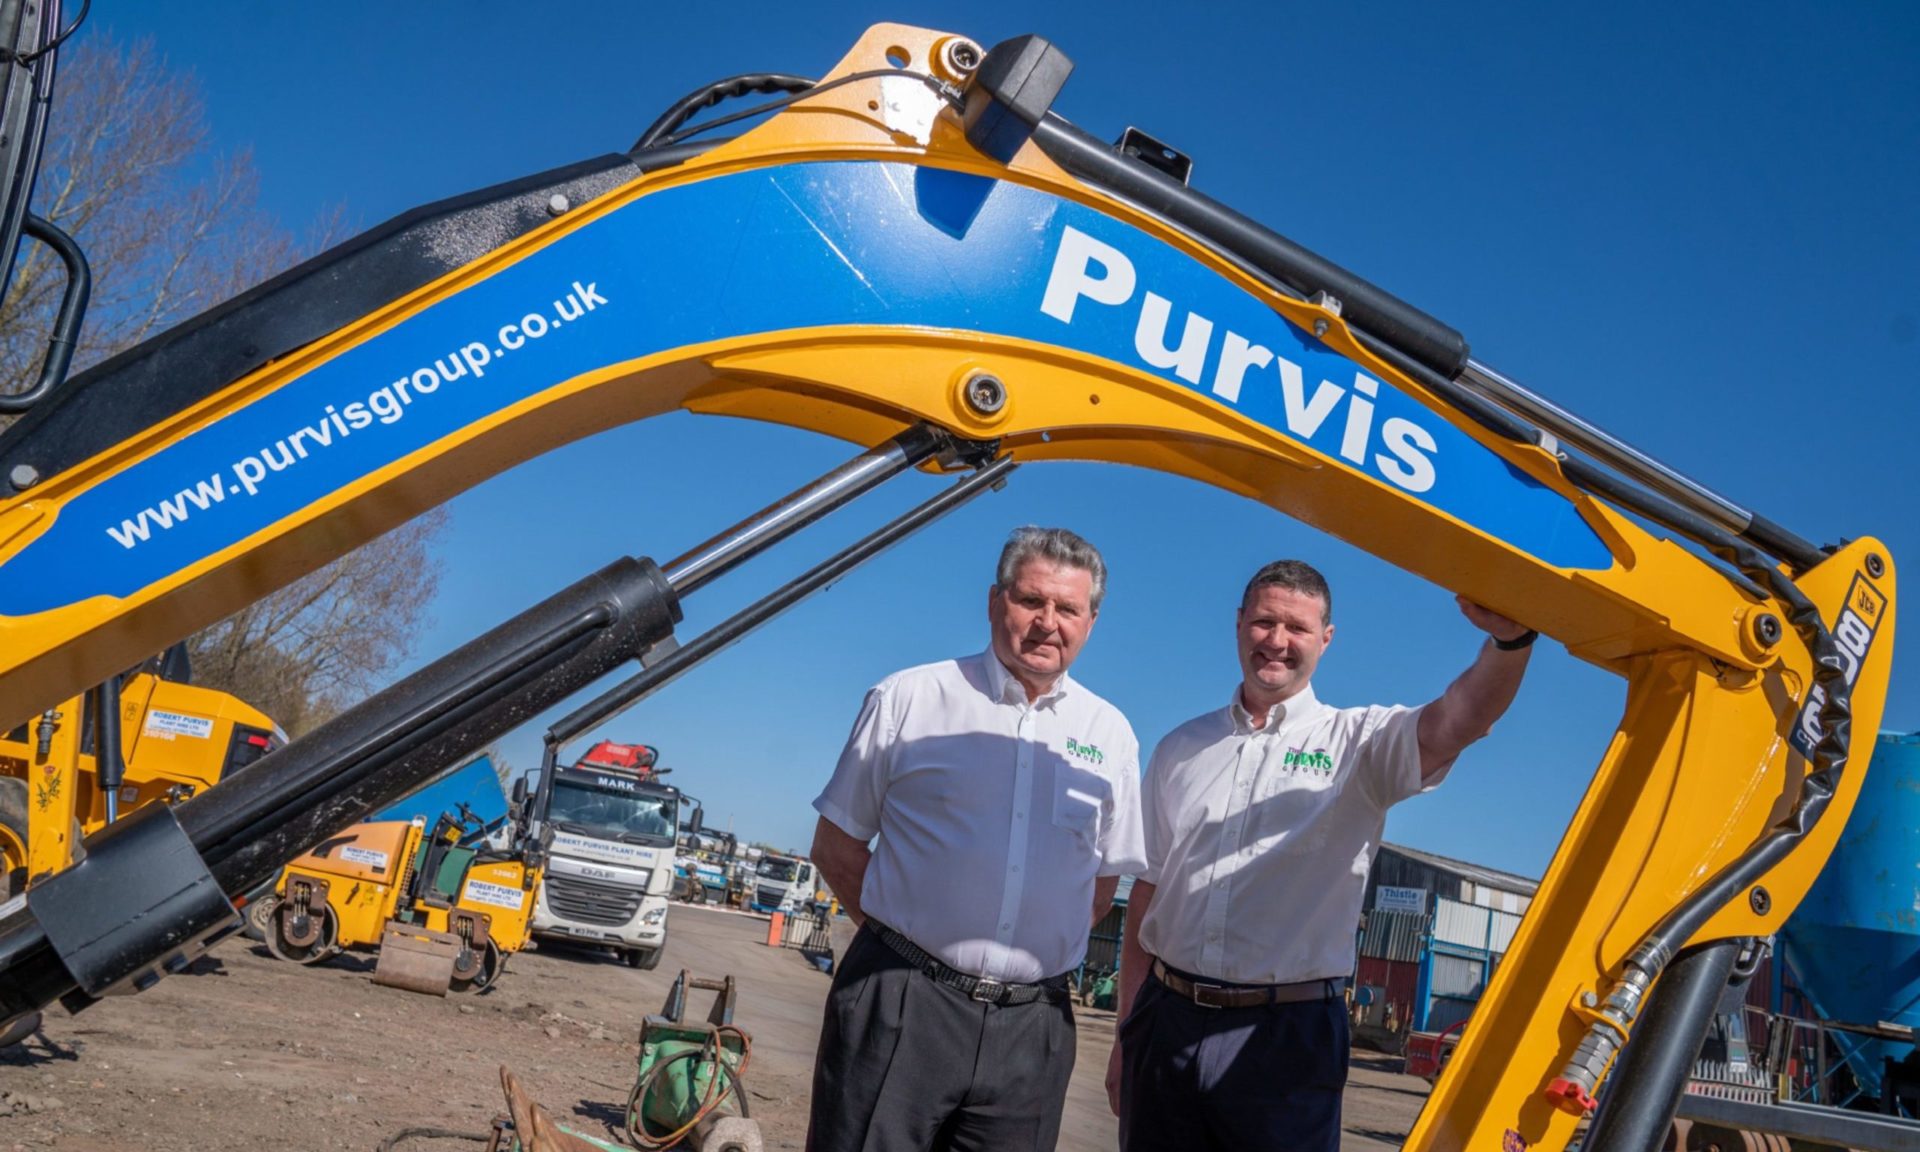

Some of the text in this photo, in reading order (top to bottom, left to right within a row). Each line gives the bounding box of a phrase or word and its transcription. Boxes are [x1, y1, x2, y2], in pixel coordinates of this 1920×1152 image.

[1039, 225, 1438, 493] Purvis
[106, 279, 609, 550] www.purvisgroup.co.uk
[1859, 587, 1876, 617] JCB
[153, 711, 209, 726] ROBERT PURVIS
[598, 776, 636, 791] MARK
[347, 847, 366, 855] ROBERT
[583, 841, 610, 851] PURVIS
[611, 846, 634, 855] PLANT
[636, 850, 653, 859] HIRE
[581, 867, 616, 878] DAF
[470, 881, 522, 897] ROBERT PURVIS
[1385, 888, 1418, 899] Thistle
